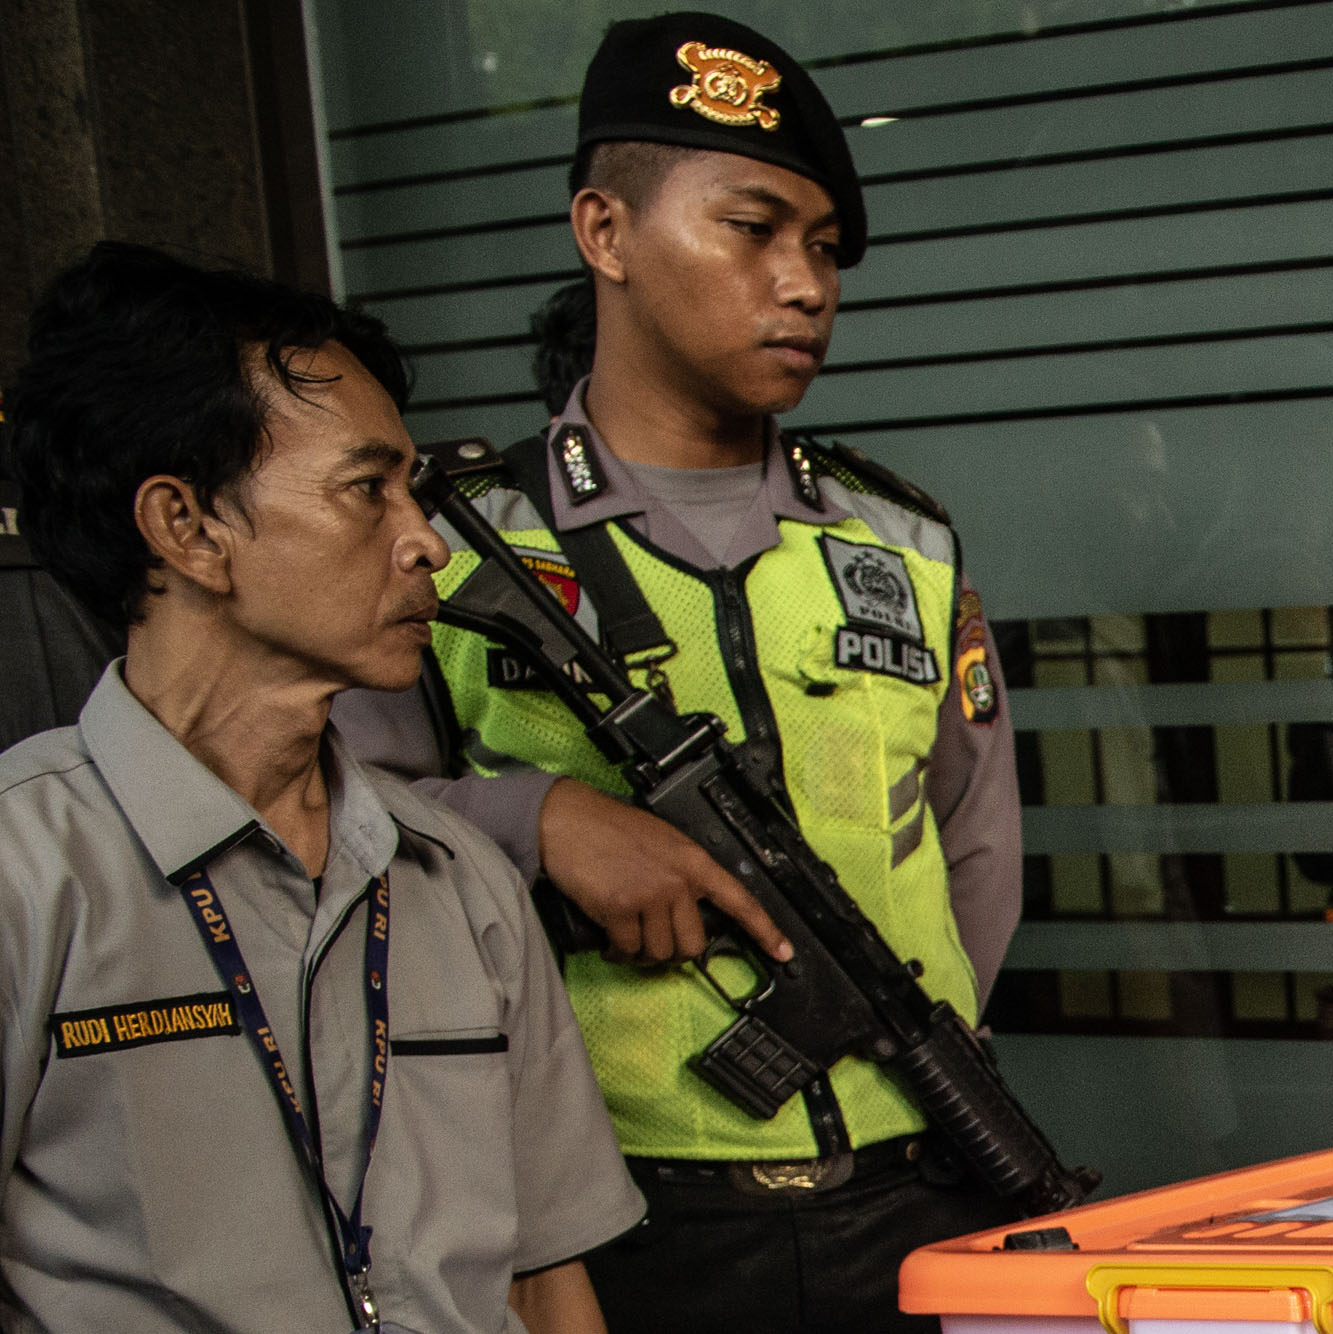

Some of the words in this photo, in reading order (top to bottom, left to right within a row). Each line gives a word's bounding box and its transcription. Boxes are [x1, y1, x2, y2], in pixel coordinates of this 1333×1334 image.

[837, 629, 938, 681] POLISI
[377, 873, 389, 908] PU
[191, 888, 230, 943] KPU
[373, 912, 388, 941] RI
[61, 1018, 111, 1050] RUDI
[256, 1026, 278, 1053] RI
[374, 1018, 387, 1074] KPU
